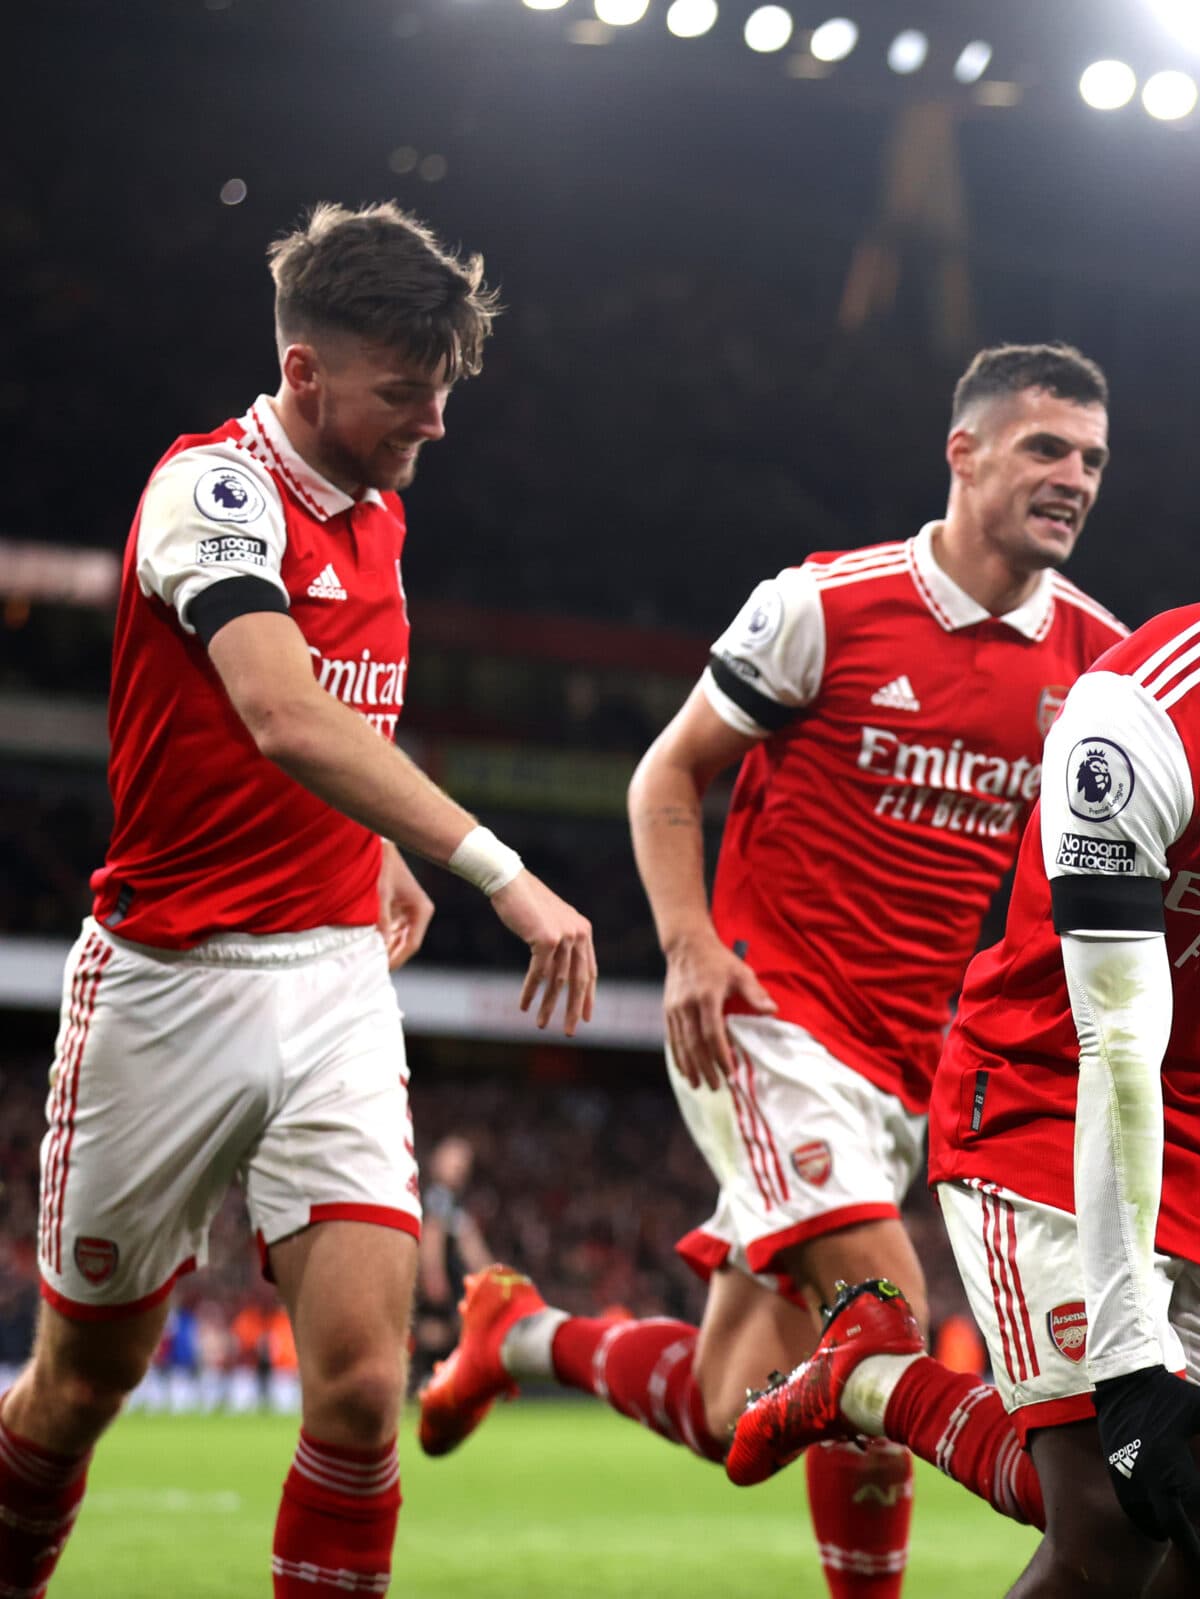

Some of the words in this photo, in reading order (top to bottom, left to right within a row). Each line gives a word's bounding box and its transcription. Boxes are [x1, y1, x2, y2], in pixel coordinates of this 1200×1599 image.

[200, 541, 220, 554] No
[221, 538, 261, 554] room
[308, 646, 407, 706] mirat
[857, 726, 1041, 799] Emirate
[1062, 834, 1080, 852] No
[1081, 839, 1127, 858] room
[1079, 853, 1134, 872] racism
[1053, 1312, 1087, 1325] Arsena
[1108, 1438, 1142, 1465] adidas
